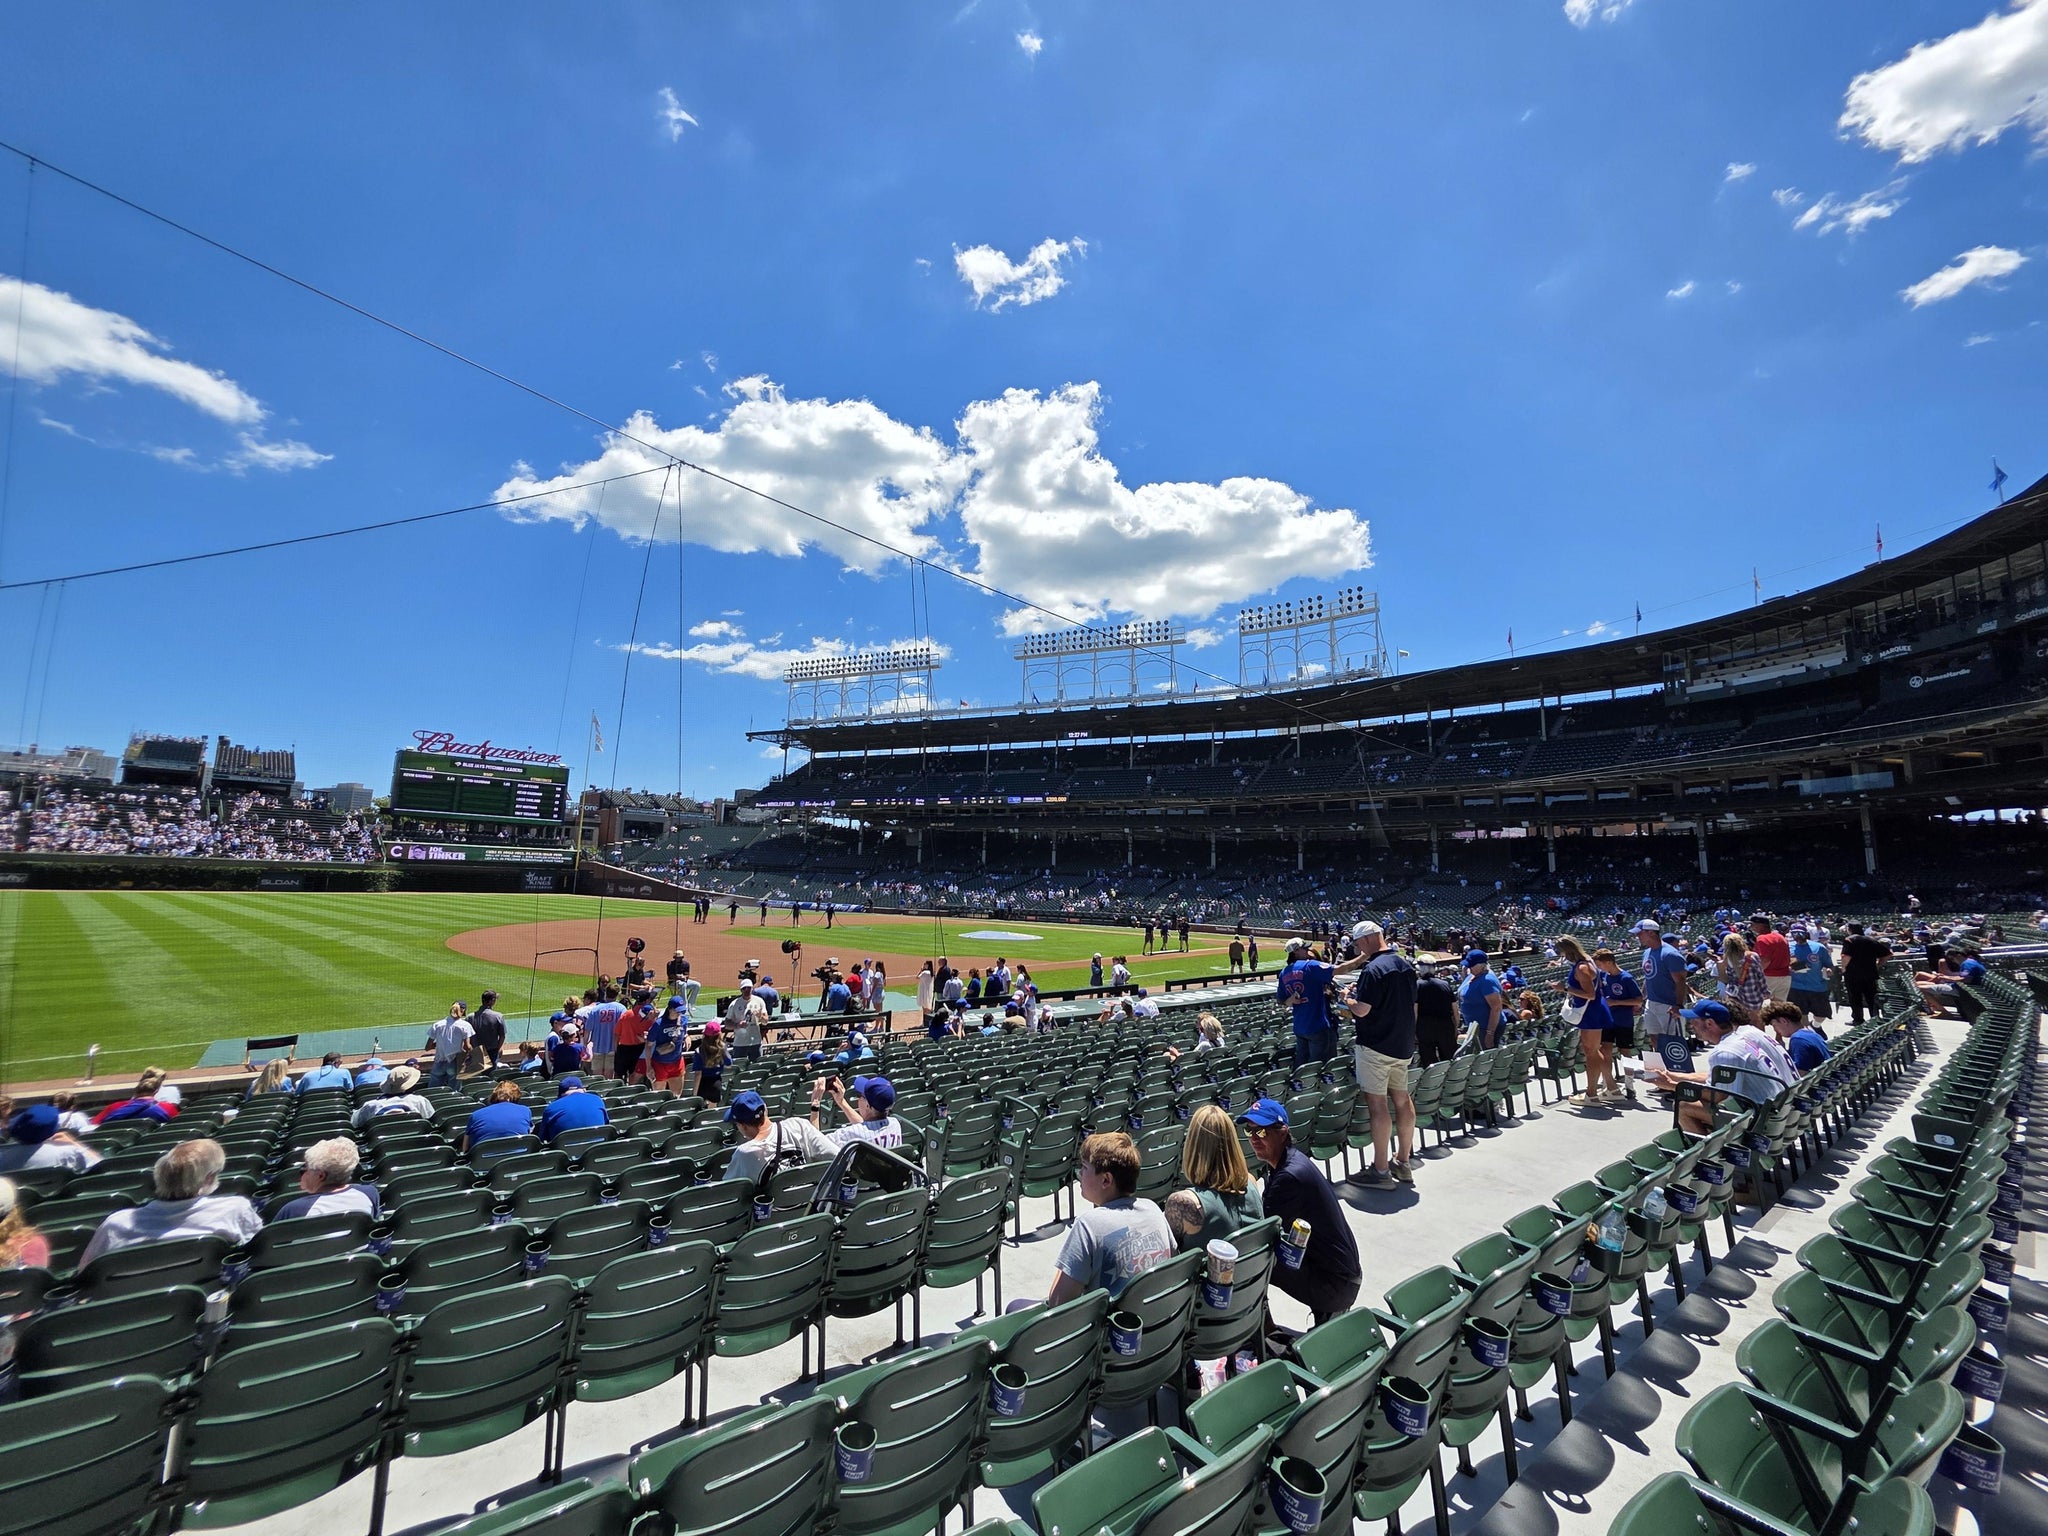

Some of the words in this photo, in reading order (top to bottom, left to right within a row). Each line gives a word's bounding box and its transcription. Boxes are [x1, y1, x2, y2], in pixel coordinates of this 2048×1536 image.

[1880, 645, 1912, 658] MARQUEE
[1924, 668, 1971, 683] JamesHardie
[413, 730, 562, 763] Budweiser
[429, 851, 466, 860] TINKER
[600, 1010, 615, 1023] 25
[1720, 1070, 1731, 1078] 109
[1683, 1088, 1695, 1097] 108
[892, 1205, 899, 1213] 11
[788, 1233, 798, 1241] 10
[844, 1470, 865, 1480] Hefty
[1284, 1503, 1308, 1522] Hefty
